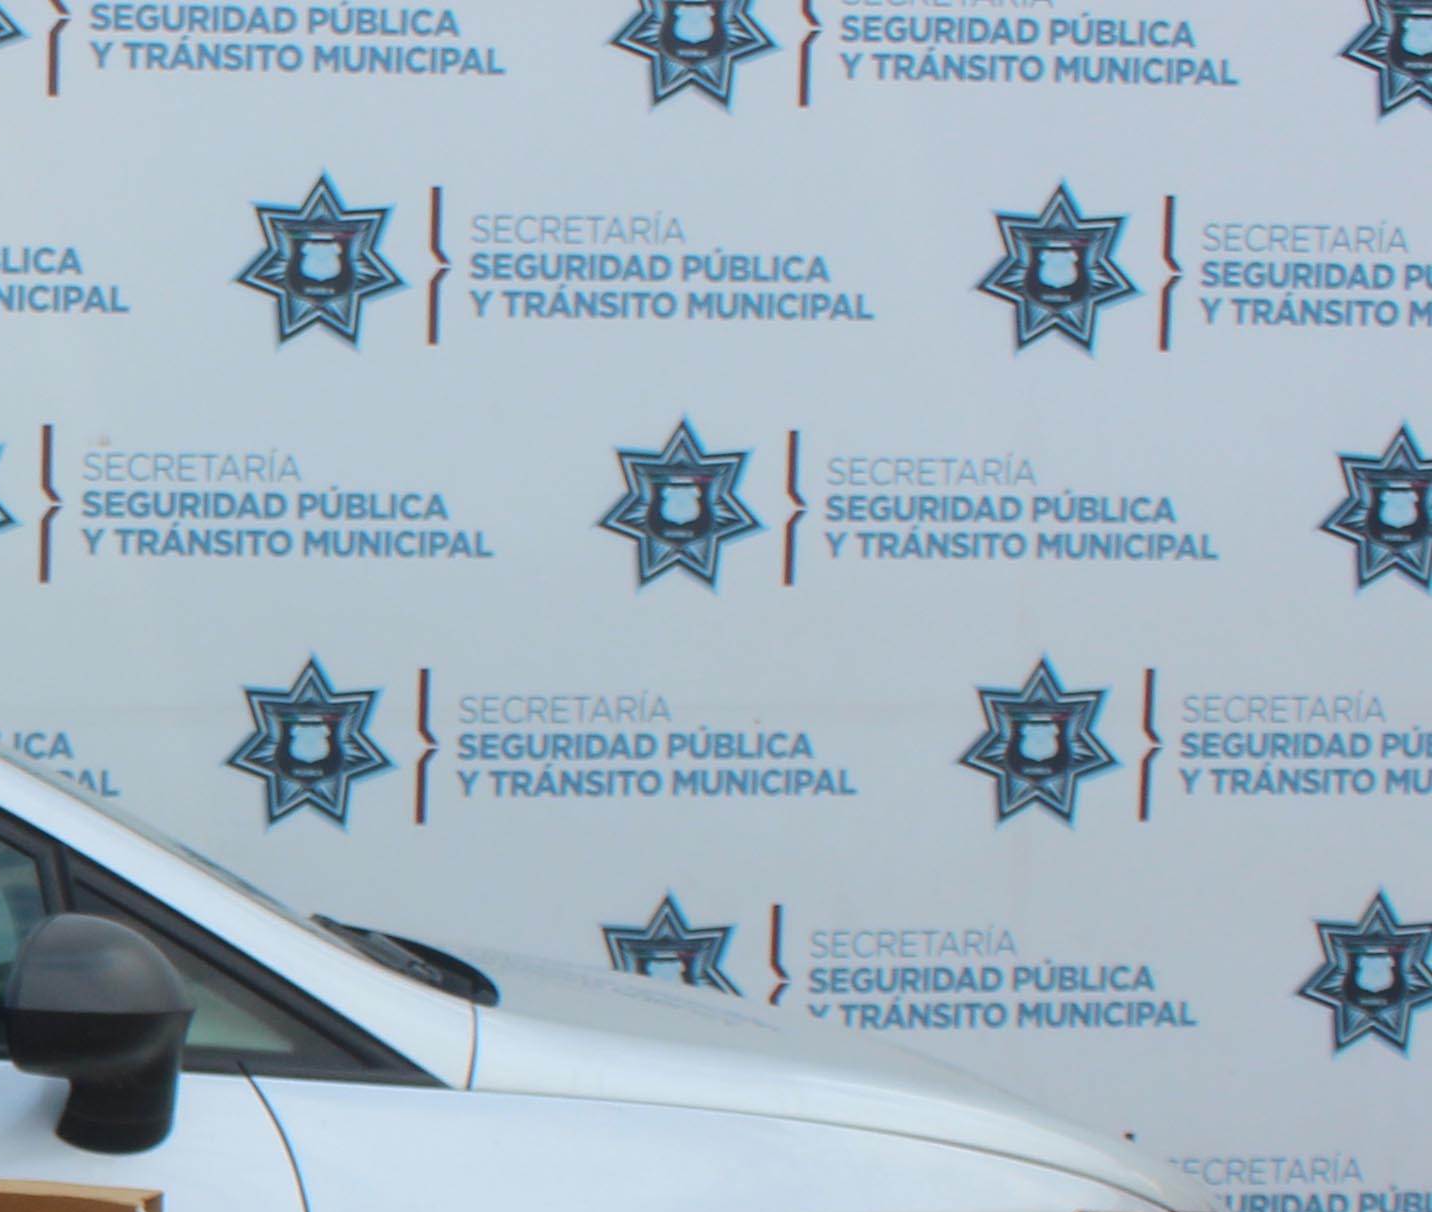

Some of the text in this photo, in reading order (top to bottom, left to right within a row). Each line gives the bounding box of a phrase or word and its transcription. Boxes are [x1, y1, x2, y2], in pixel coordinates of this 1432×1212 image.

[91, 0, 462, 35] SEGURIDAD PÚBLICA
[842, 11, 1197, 46] SEGURIDAD PÚBLICA
[90, 33, 507, 73] Y TRÁNSITO MUNICIPAL
[840, 44, 1241, 84] Y TRÁNSITO MUNICIPAL
[473, 209, 687, 243] SECRETARÍA
[1204, 219, 1408, 252] SECRETARÍA
[471, 246, 832, 282] SEGURIDAD PÚBLICA
[1202, 261, 1397, 288] SEGURIDAD
[470, 282, 876, 319] Y TRÁNSITO MUNICIPAL
[1201, 297, 1224, 324] Y
[1231, 290, 1401, 325] TRÁNSITO
[84, 447, 304, 481] SECRETARÍA
[828, 452, 1037, 485] SECRETARÍA
[83, 484, 449, 520] SEGURIDAD PÚBLICA
[827, 488, 1178, 523] SEGURIDAD PÚBLICA
[82, 520, 496, 557] Y TRÁNSITO MUNICIPAL
[826, 523, 1220, 559] Y TRÁNSITO MUNICIPAL
[461, 691, 672, 724] SECRETARÍA
[1184, 690, 1386, 723] SECRETARÍA
[458, 724, 816, 760] SEGURIDAD PÚBLICA
[1181, 732, 1374, 758] SEGURIDAD
[457, 761, 859, 797] Y TRÁNSITO MUNICIPAL
[1180, 760, 1378, 794] Y TRÁNSITO
[812, 925, 1017, 958] SECRETARÍA
[810, 957, 1156, 993] SEGURIDAD PÚBLICA
[840, 994, 1010, 1029] TRÁNSITO
[1018, 1001, 1200, 1027] MUNICIPAL
[1169, 1152, 1364, 1184] ECRETARÍA
